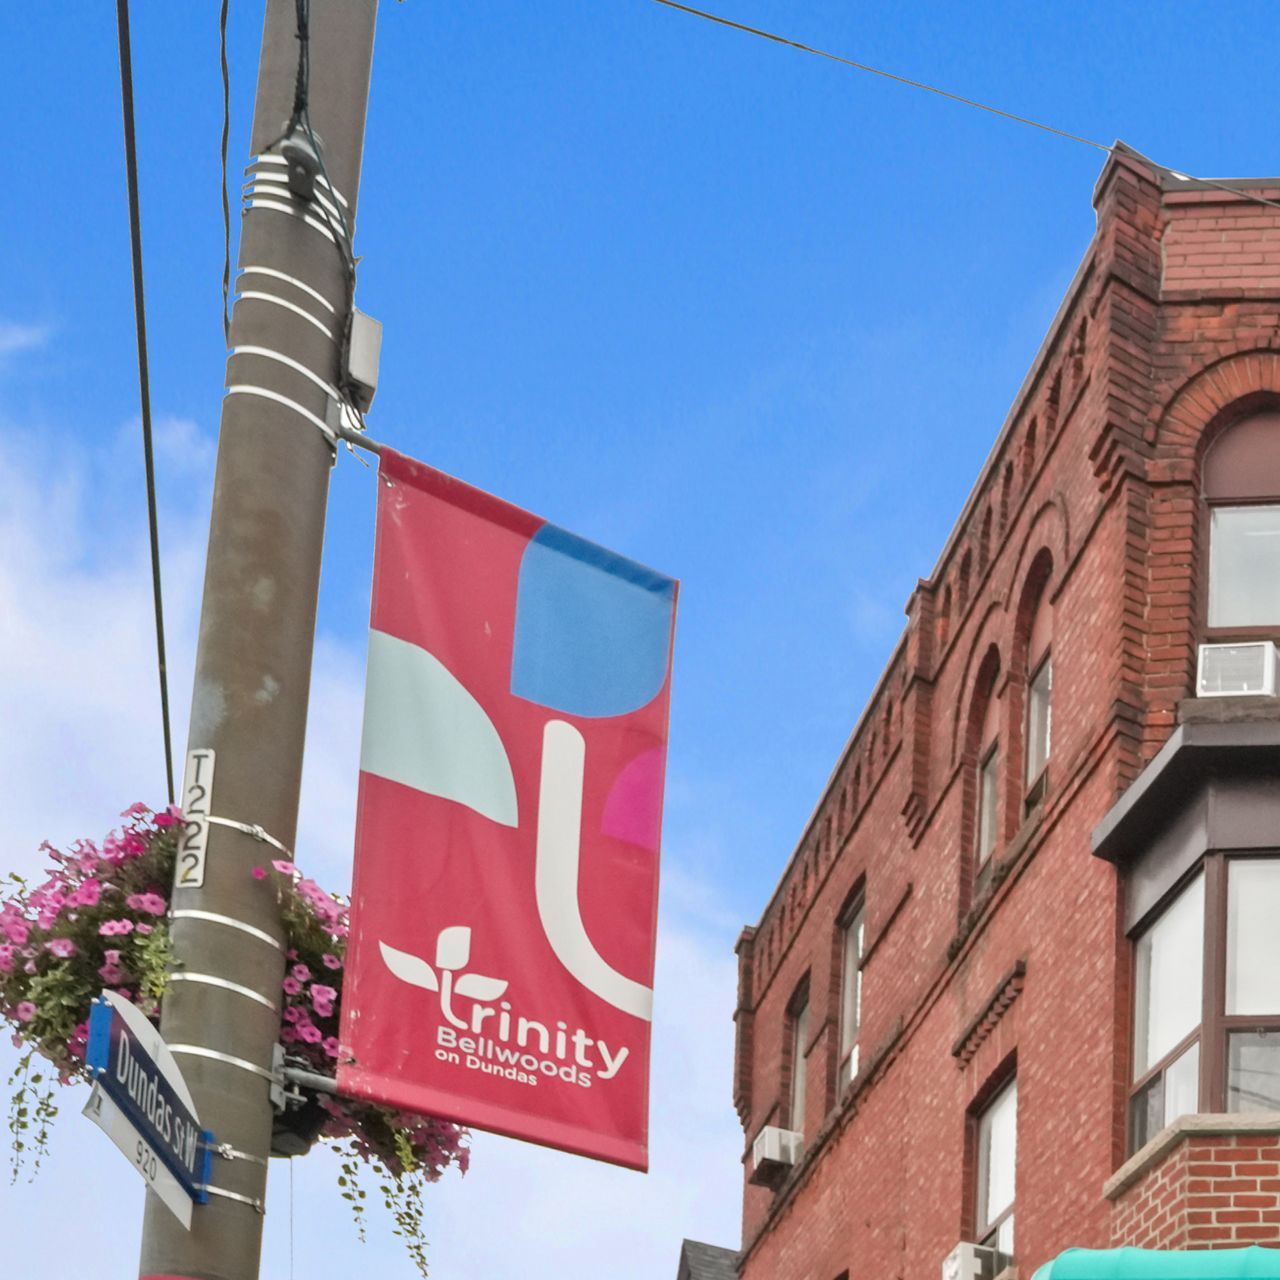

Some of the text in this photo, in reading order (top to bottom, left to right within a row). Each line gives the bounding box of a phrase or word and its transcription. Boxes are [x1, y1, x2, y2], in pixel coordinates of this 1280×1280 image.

[434, 1047, 538, 1087] on Dundas
[436, 1027, 592, 1088] Bellwoods
[116, 1029, 198, 1173] Dundas St W
[136, 1140, 157, 1181] 920
